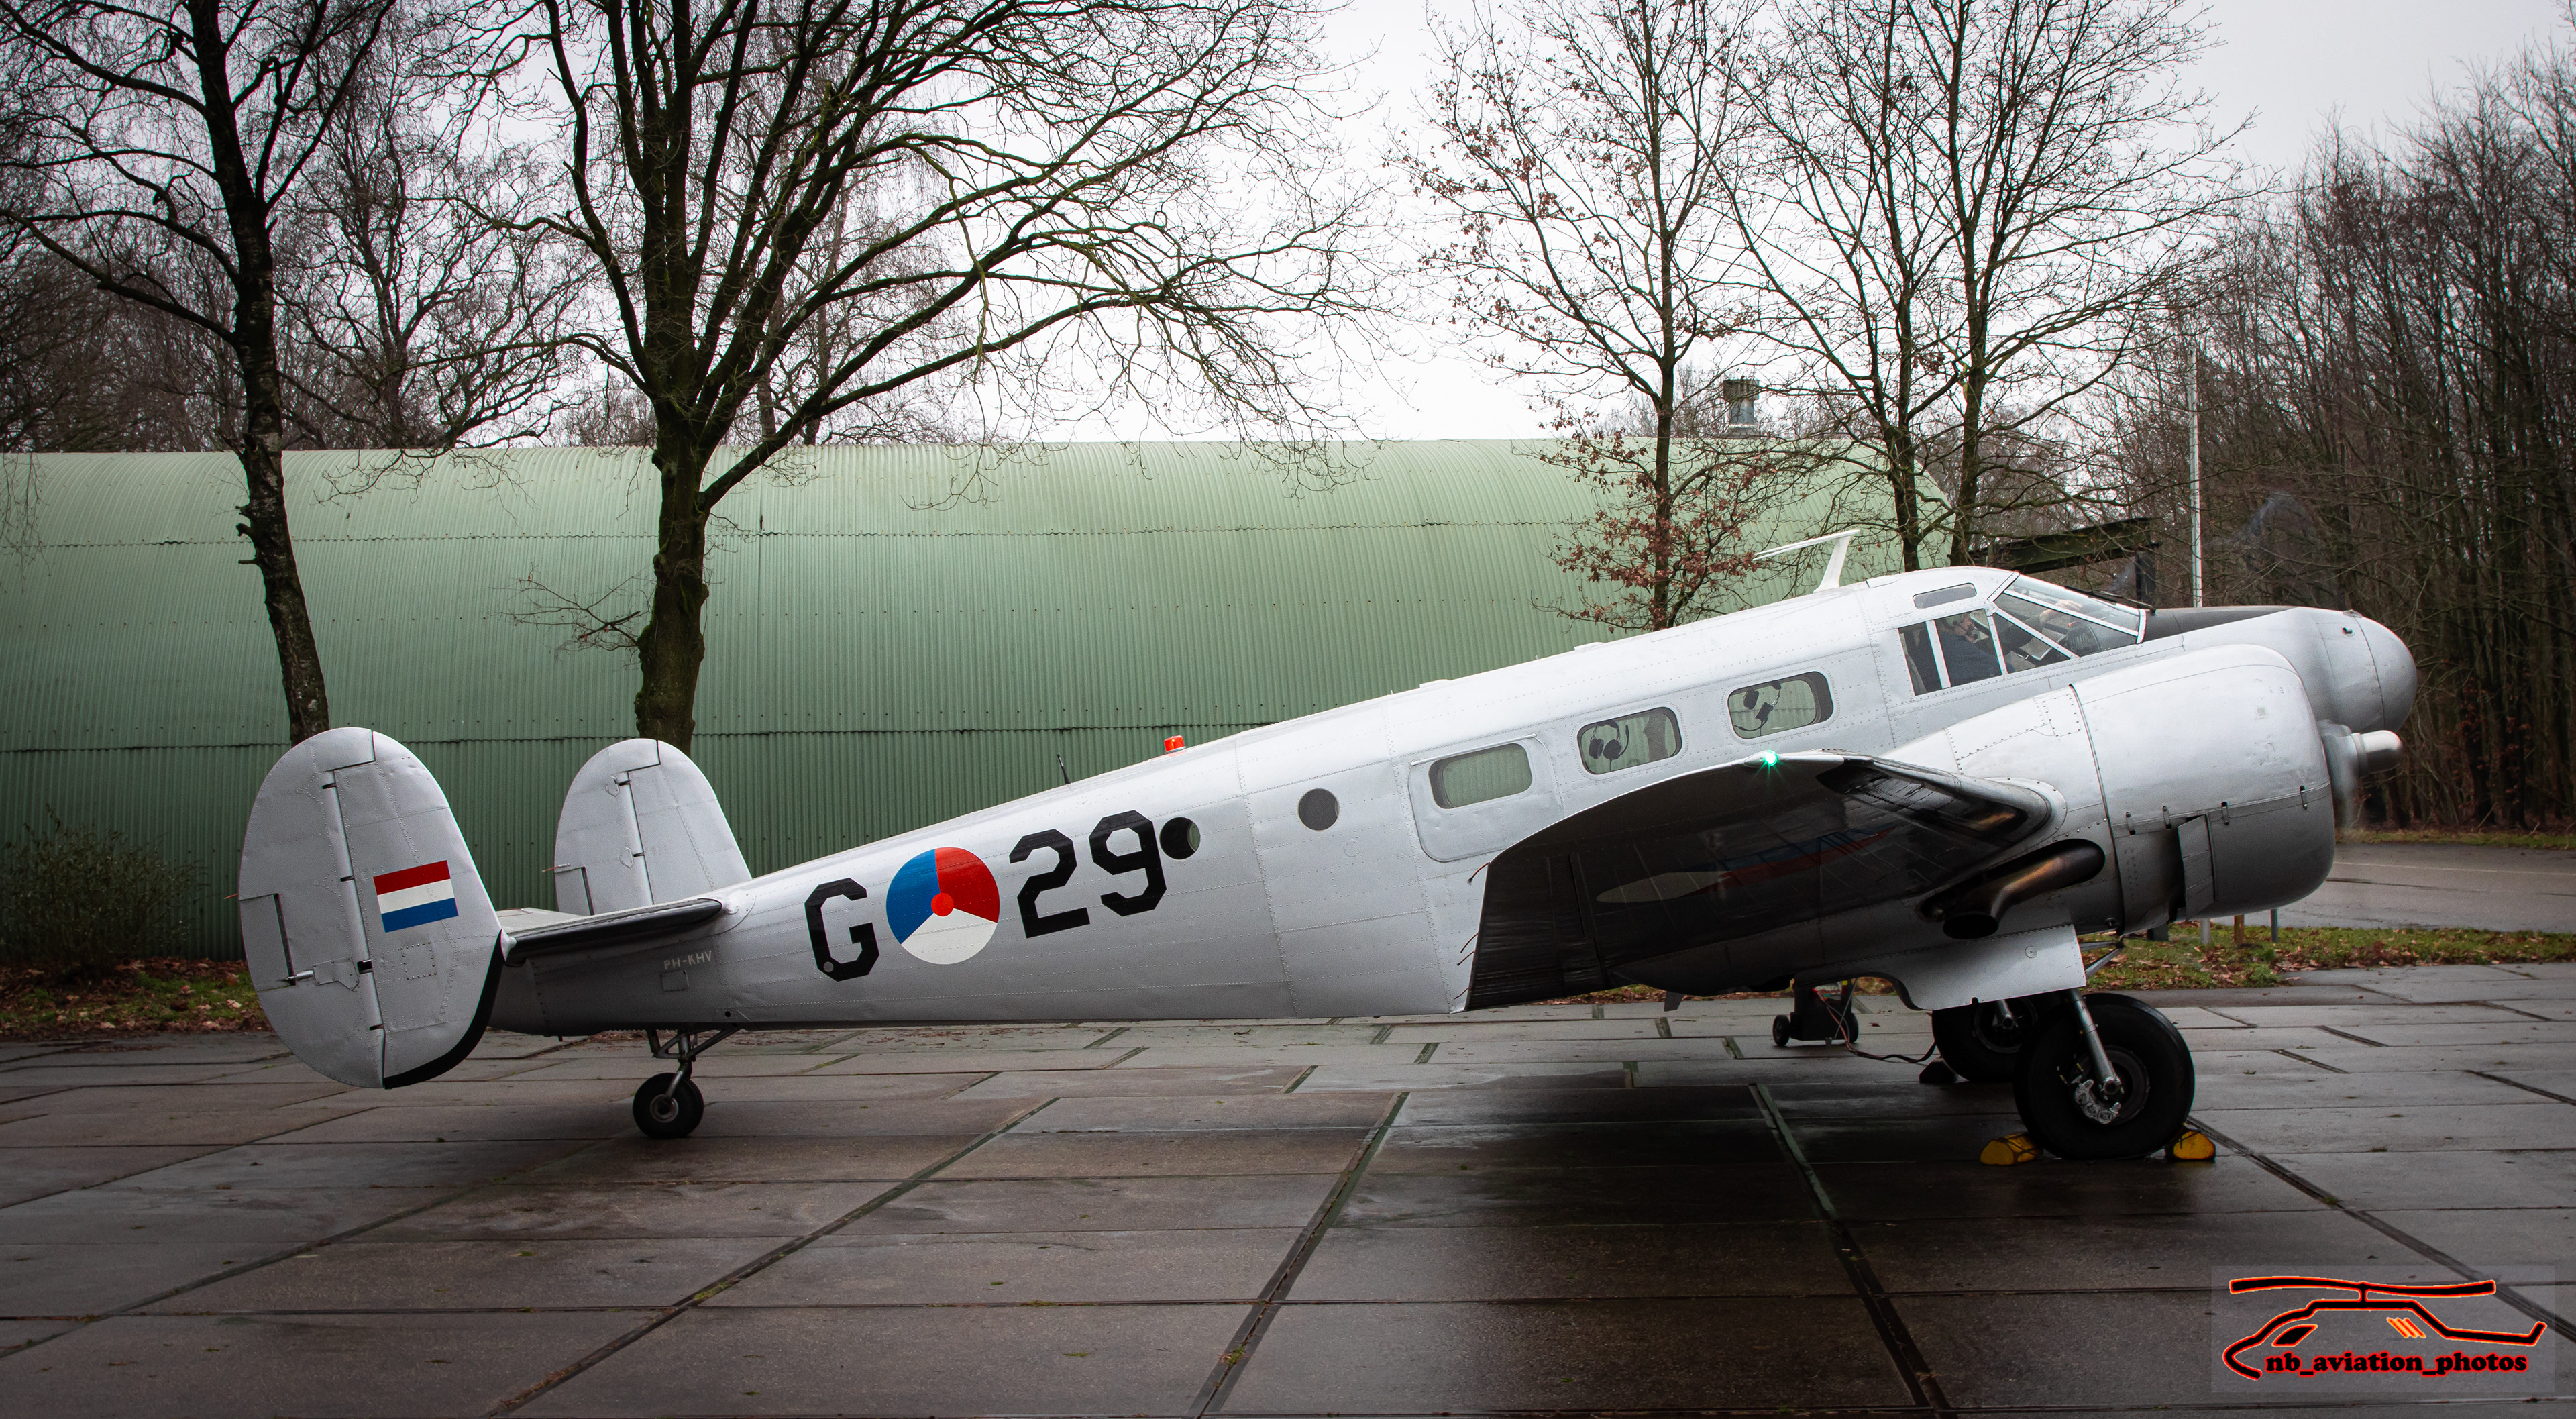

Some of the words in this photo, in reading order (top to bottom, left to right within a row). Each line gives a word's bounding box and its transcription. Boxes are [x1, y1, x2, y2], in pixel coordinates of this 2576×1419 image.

[805, 878, 880, 982] G
[1010, 810, 1167, 938] 29
[663, 951, 712, 970] PH-KHV
